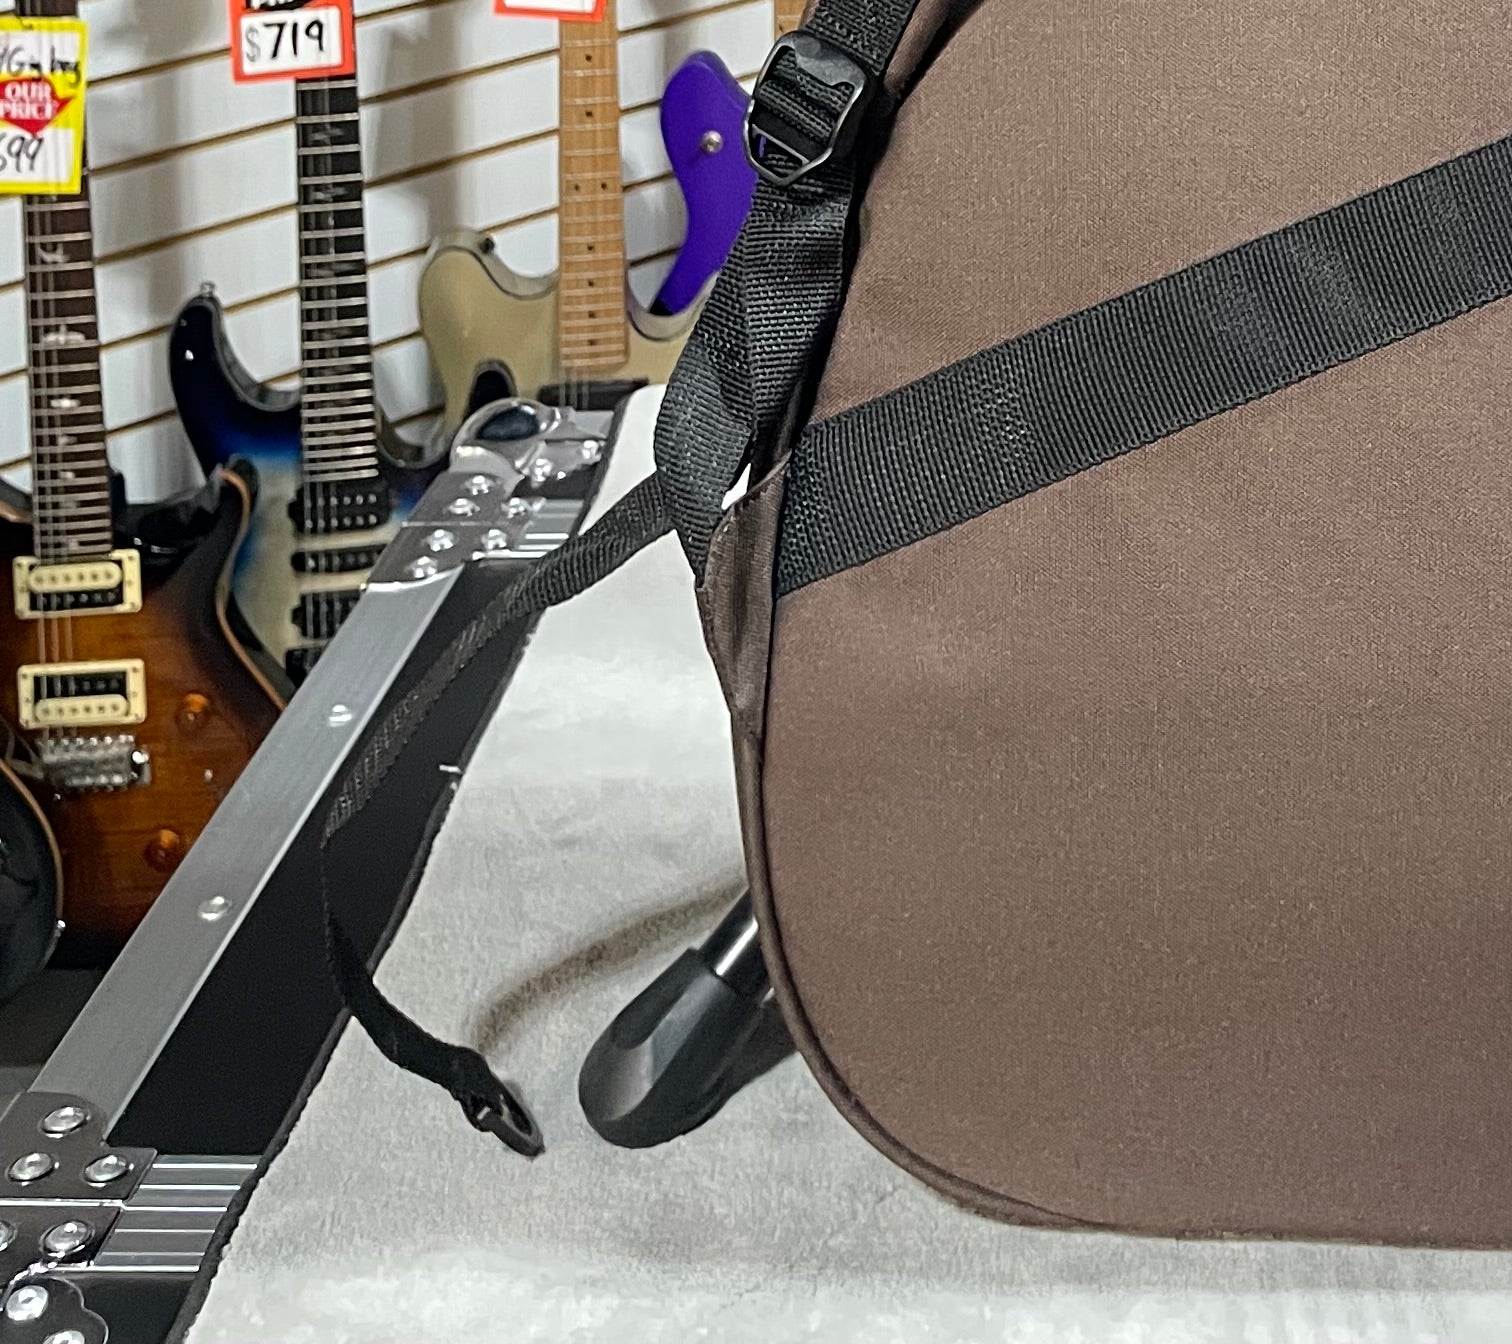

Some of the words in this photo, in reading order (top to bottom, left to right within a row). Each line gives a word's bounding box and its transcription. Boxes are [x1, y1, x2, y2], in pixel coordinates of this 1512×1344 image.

[244, 18, 325, 63] $719
[4, 81, 52, 101] OUR
[0, 98, 60, 120] PRICE
